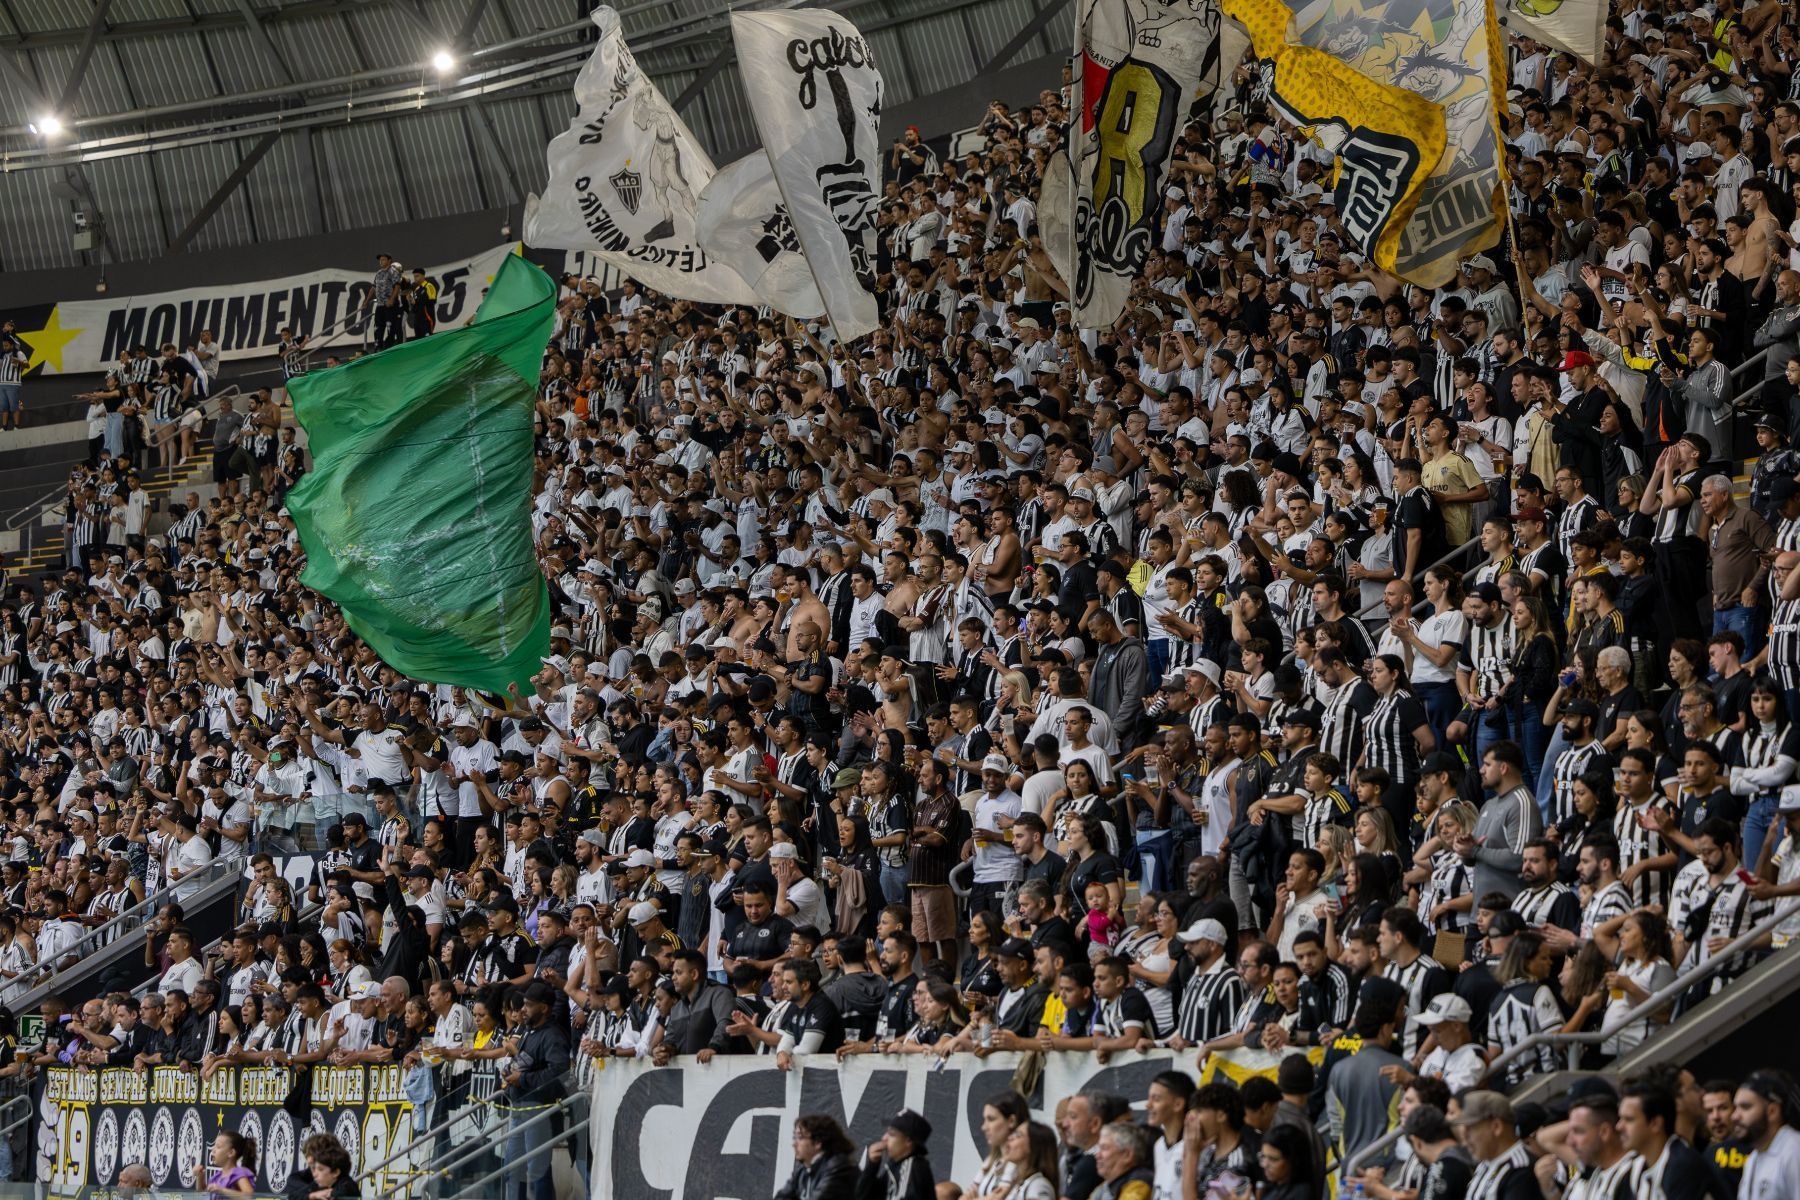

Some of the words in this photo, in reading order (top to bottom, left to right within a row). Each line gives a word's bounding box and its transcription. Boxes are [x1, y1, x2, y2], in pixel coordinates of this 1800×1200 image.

[100, 279, 374, 362] MOVIMENTO
[1772, 623, 1797, 634] BETANO
[48, 1068, 98, 1104] ESTAMOS
[101, 1067, 149, 1104] SEMPRE
[151, 1065, 199, 1104] JUNTOS
[240, 1067, 290, 1105] CURTIR
